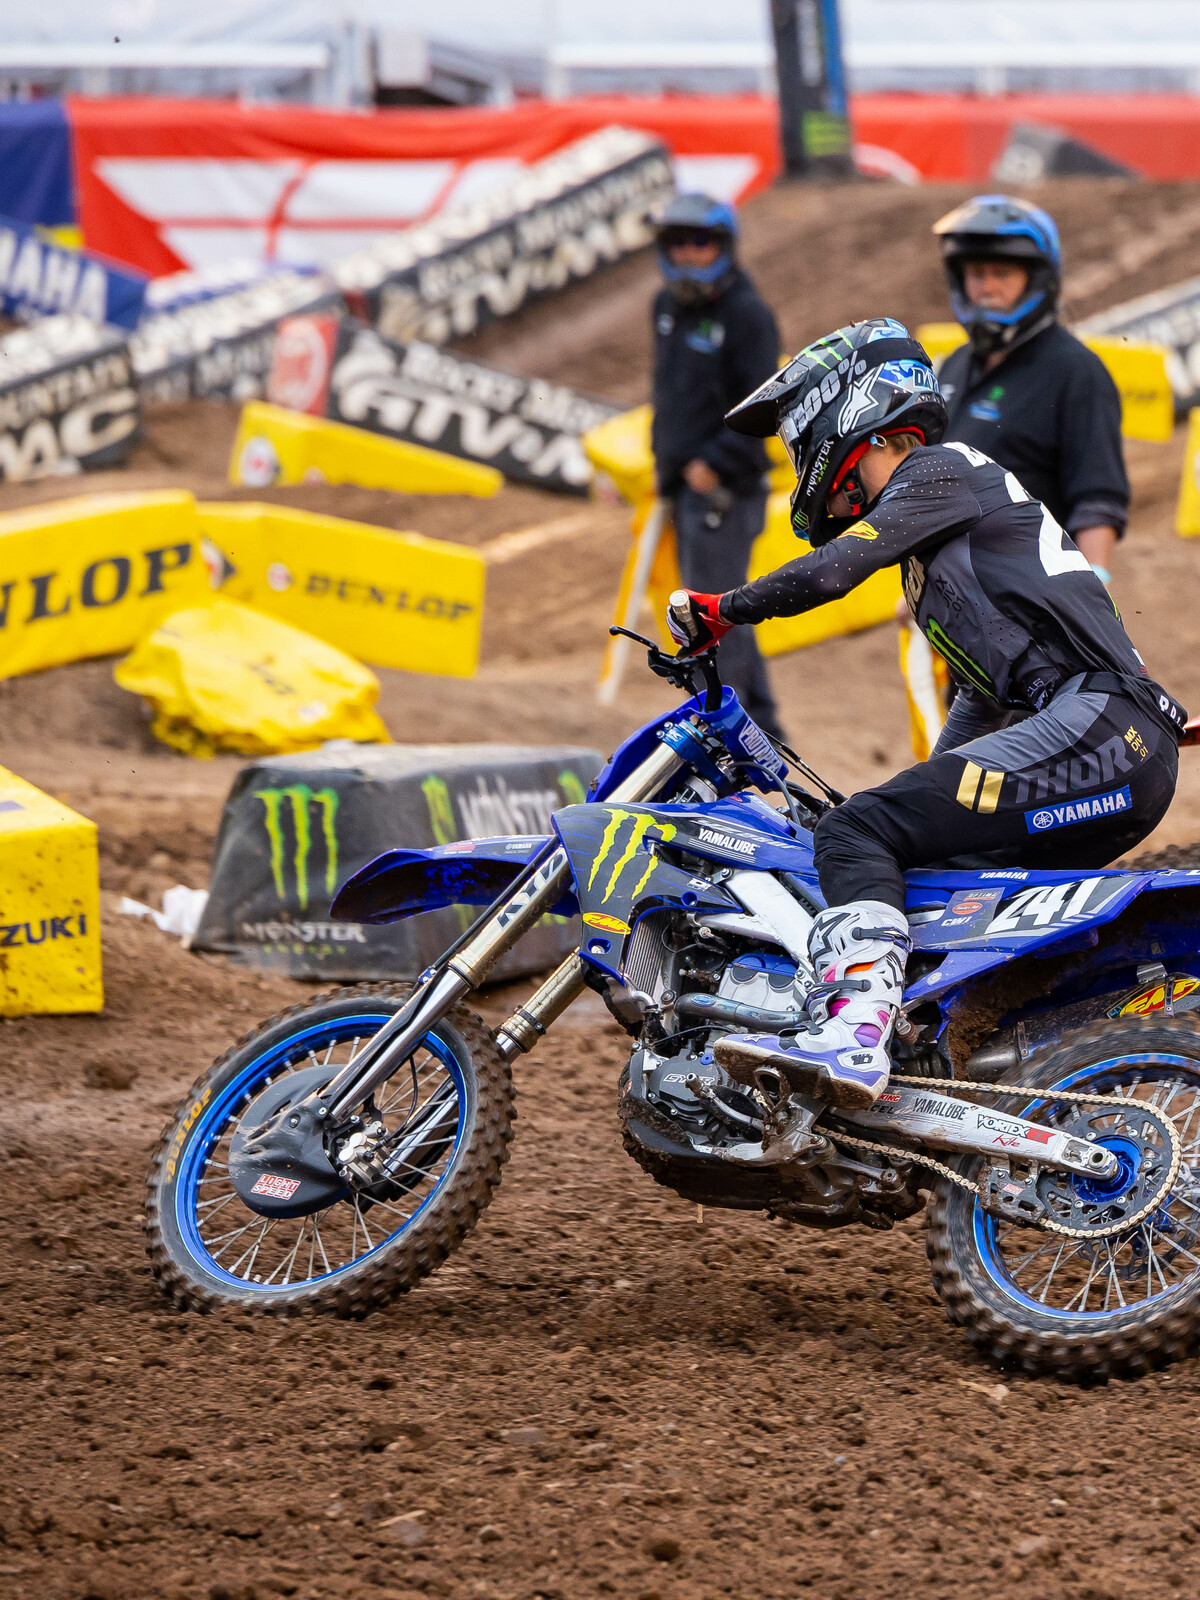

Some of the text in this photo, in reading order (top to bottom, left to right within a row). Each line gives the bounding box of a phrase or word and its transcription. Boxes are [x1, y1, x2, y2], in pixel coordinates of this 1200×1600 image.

[792, 350, 867, 434] 100%
[806, 439, 834, 497] MONSTER
[305, 571, 476, 622] DUNLOP
[1123, 725, 1139, 744] MX
[1130, 734, 1144, 752] DIV
[1005, 735, 1134, 804] THOR
[1053, 793, 1127, 824] YAMAHA
[698, 826, 760, 856] YAMALUBE
[979, 871, 1029, 881] YAMAHA
[983, 876, 1105, 935] 241
[242, 920, 367, 944] MONSTER
[662, 1073, 716, 1087] GYR
[913, 1097, 969, 1121] YAMALUBE
[165, 1087, 212, 1177] DUNLOP
[977, 1114, 1031, 1139] VORTEX
[252, 1184, 295, 1200] SPEED
[261, 1174, 301, 1190] LIGHT
